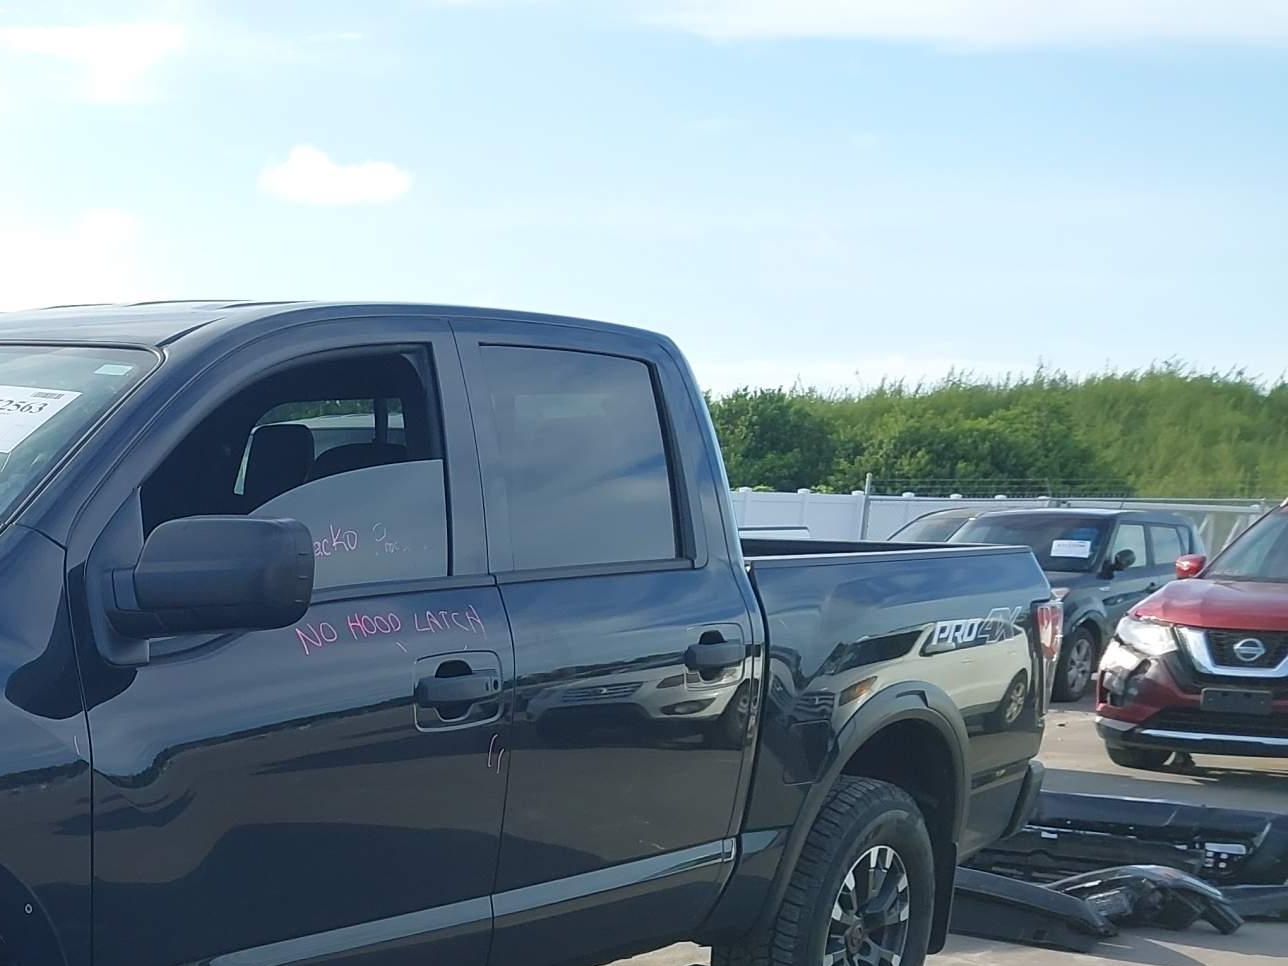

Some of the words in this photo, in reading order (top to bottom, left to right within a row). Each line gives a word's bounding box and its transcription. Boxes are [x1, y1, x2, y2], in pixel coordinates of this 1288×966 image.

[295, 612, 339, 655] NO
[346, 612, 401, 640] HOOD
[414, 605, 487, 640] LATCH
